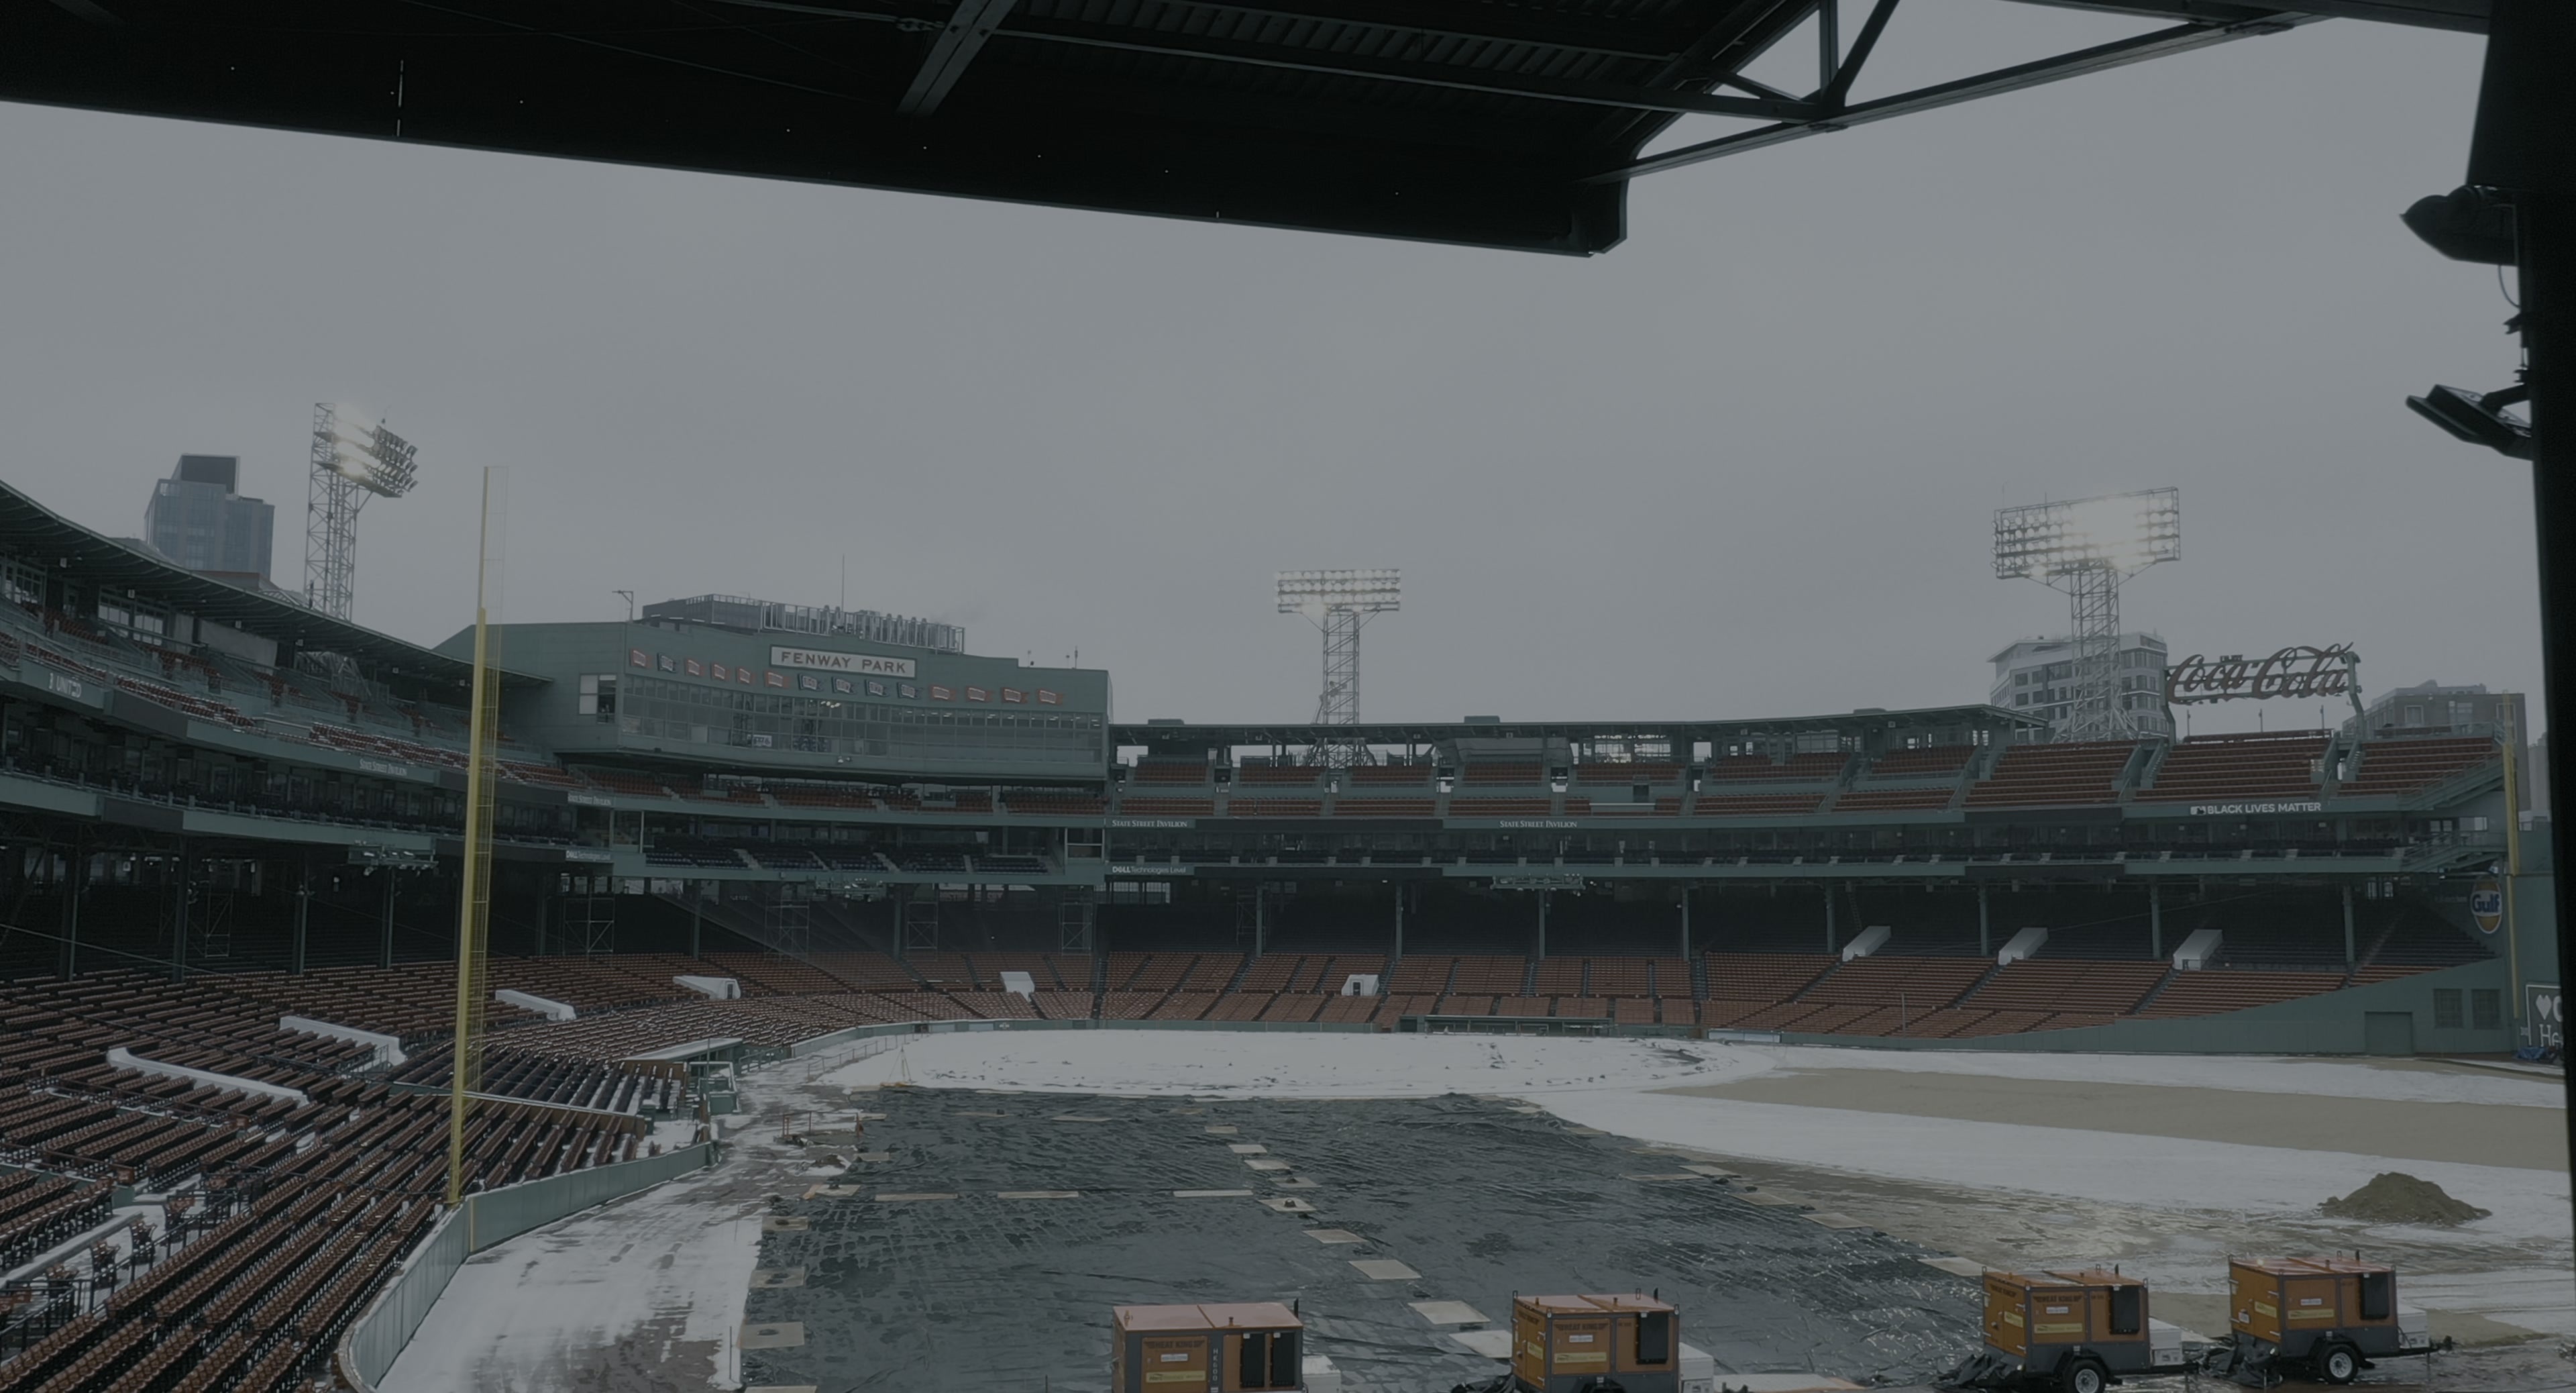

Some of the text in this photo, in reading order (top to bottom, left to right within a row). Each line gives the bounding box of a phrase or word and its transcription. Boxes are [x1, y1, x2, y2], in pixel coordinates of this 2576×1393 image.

[781, 651, 906, 674] FENWAY PARK
[2206, 802, 2322, 815] BLACK LIVES MATTER
[1112, 819, 1188, 827] STATE STREET PAVILION
[1499, 820, 1578, 828] STATE STREET PAVILION
[1112, 866, 1131, 874] DELL
[2473, 893, 2500, 913] Gulf
